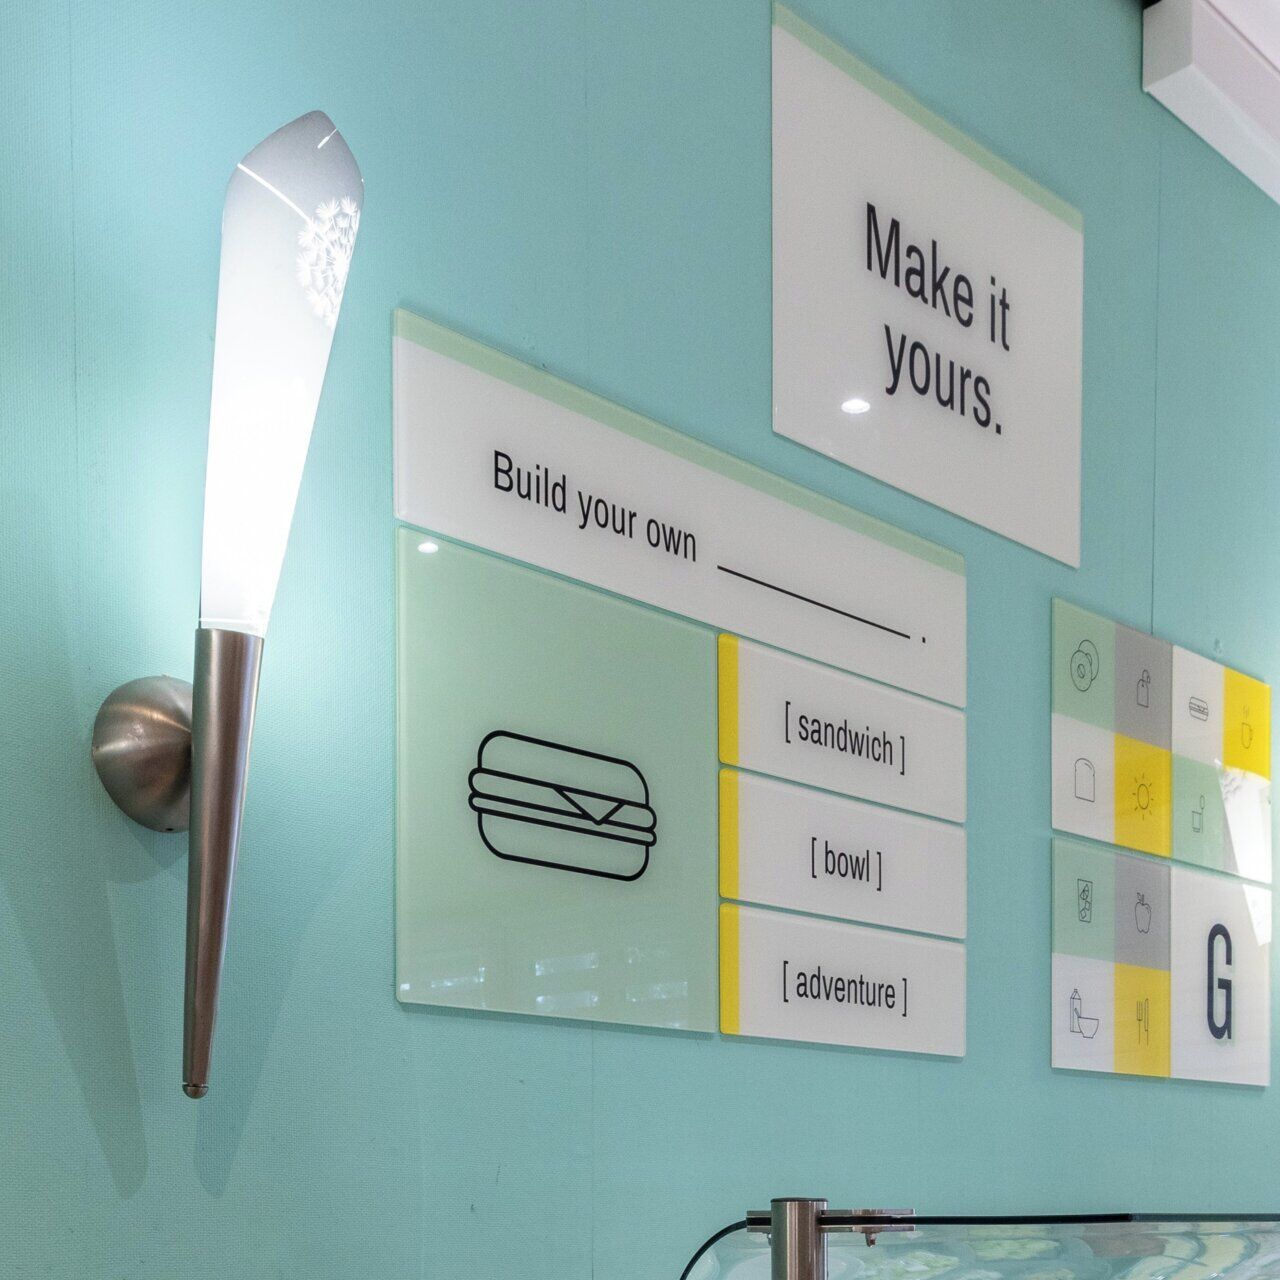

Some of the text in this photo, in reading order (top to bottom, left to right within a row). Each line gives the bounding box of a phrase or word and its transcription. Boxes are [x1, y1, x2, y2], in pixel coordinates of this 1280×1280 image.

[866, 201, 1011, 352] Make it
[884, 323, 1002, 435] yours.
[493, 449, 697, 562] Build your own
[1206, 923, 1233, 1041] G
